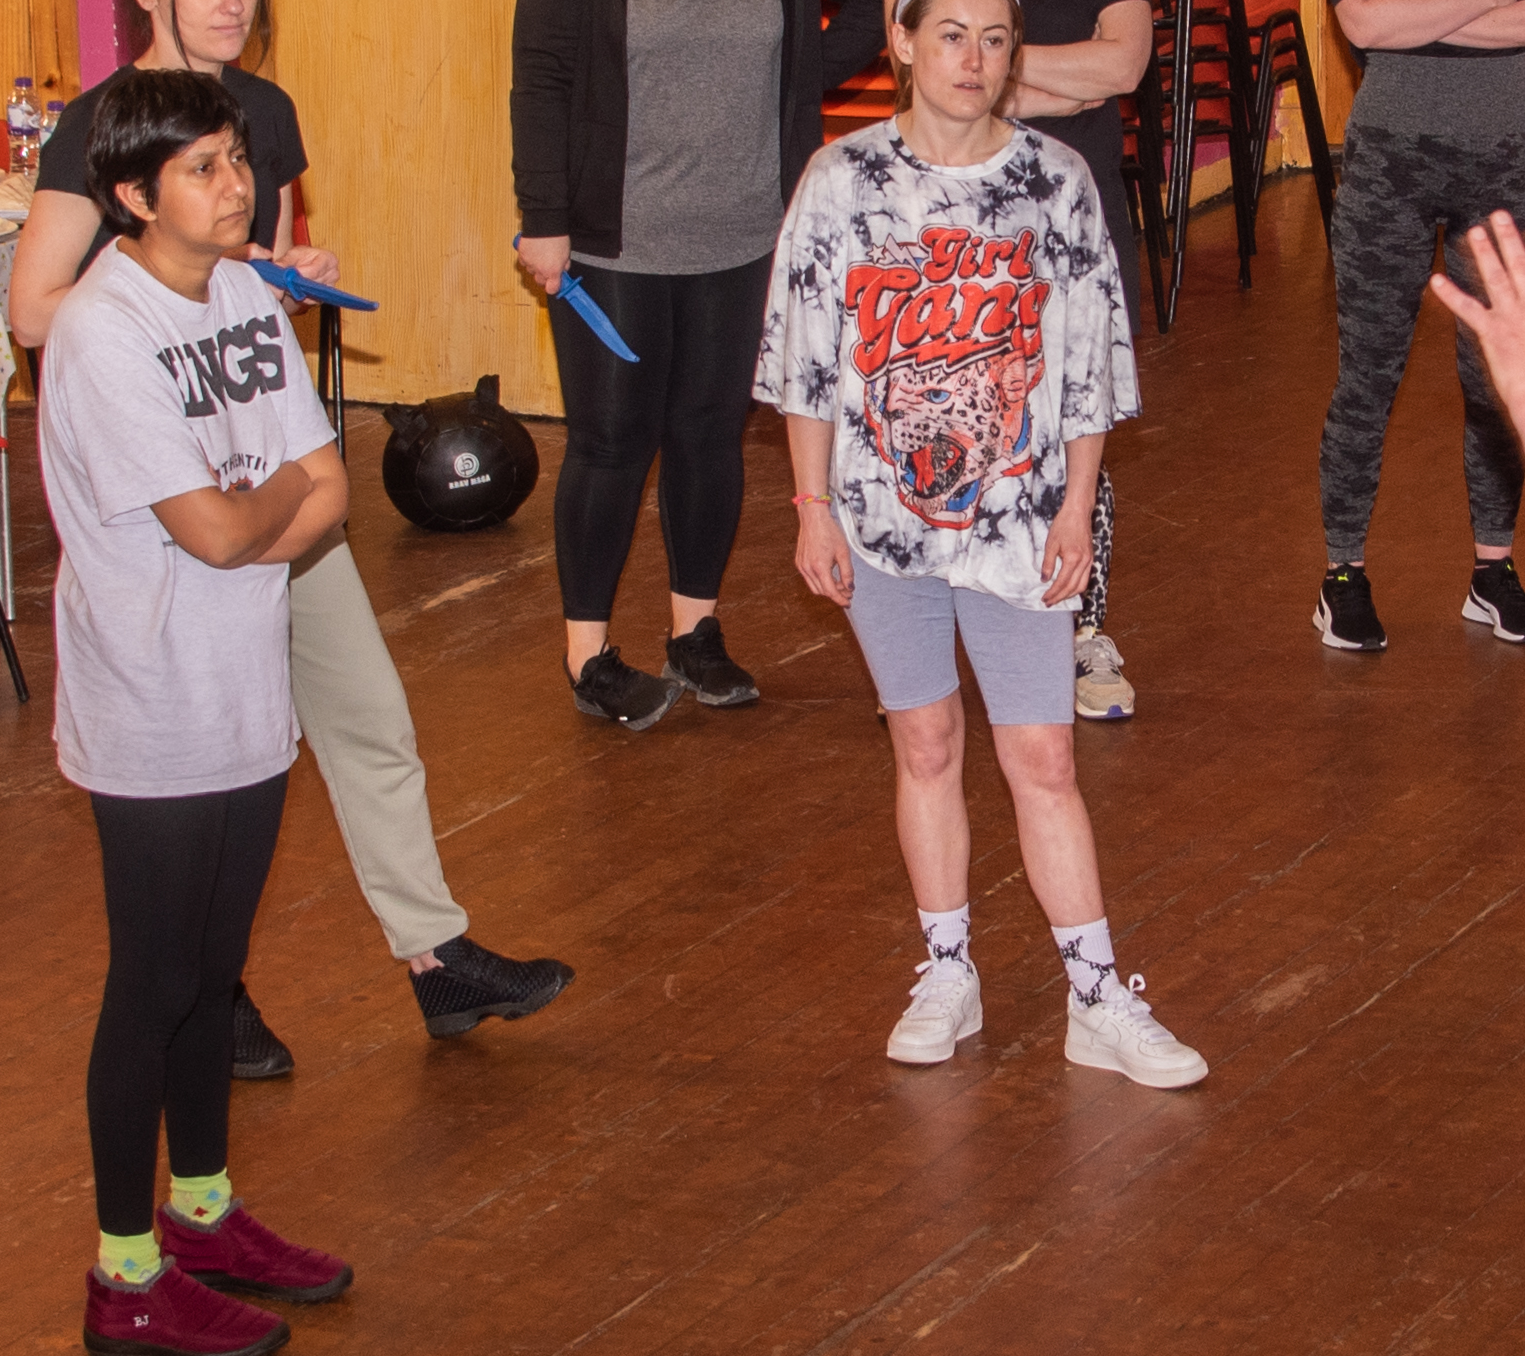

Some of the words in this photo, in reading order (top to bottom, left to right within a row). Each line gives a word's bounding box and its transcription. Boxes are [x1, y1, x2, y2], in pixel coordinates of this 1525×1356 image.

[921, 223, 1033, 280] Girl
[845, 264, 1051, 383] Gang
[134, 1315, 149, 1327] BJ
